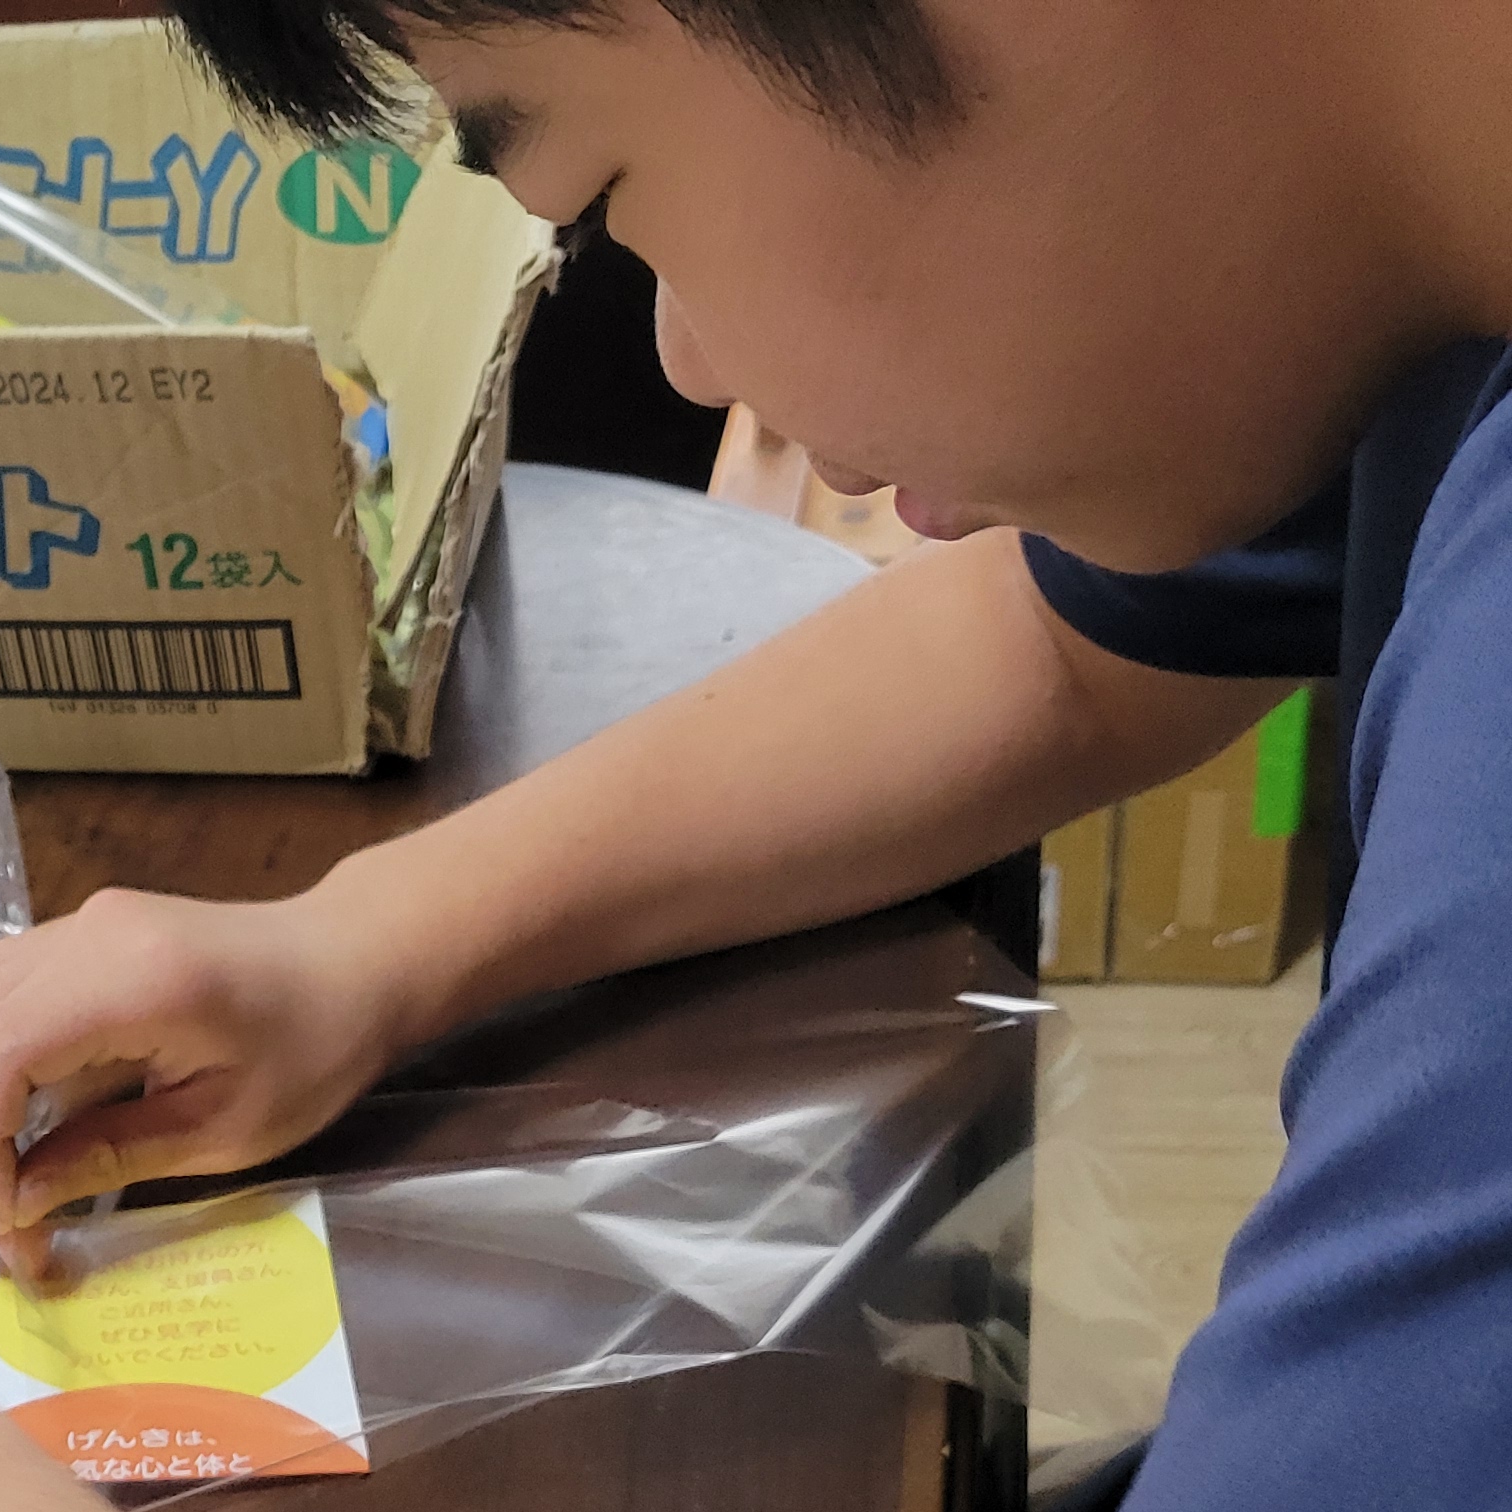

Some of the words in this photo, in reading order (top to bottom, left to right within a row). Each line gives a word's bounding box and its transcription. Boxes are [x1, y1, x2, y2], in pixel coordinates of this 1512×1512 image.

[152, 366, 215, 402] EY2
[124, 530, 306, 593] 12袋入
[66, 1428, 218, 1451] げんきは、
